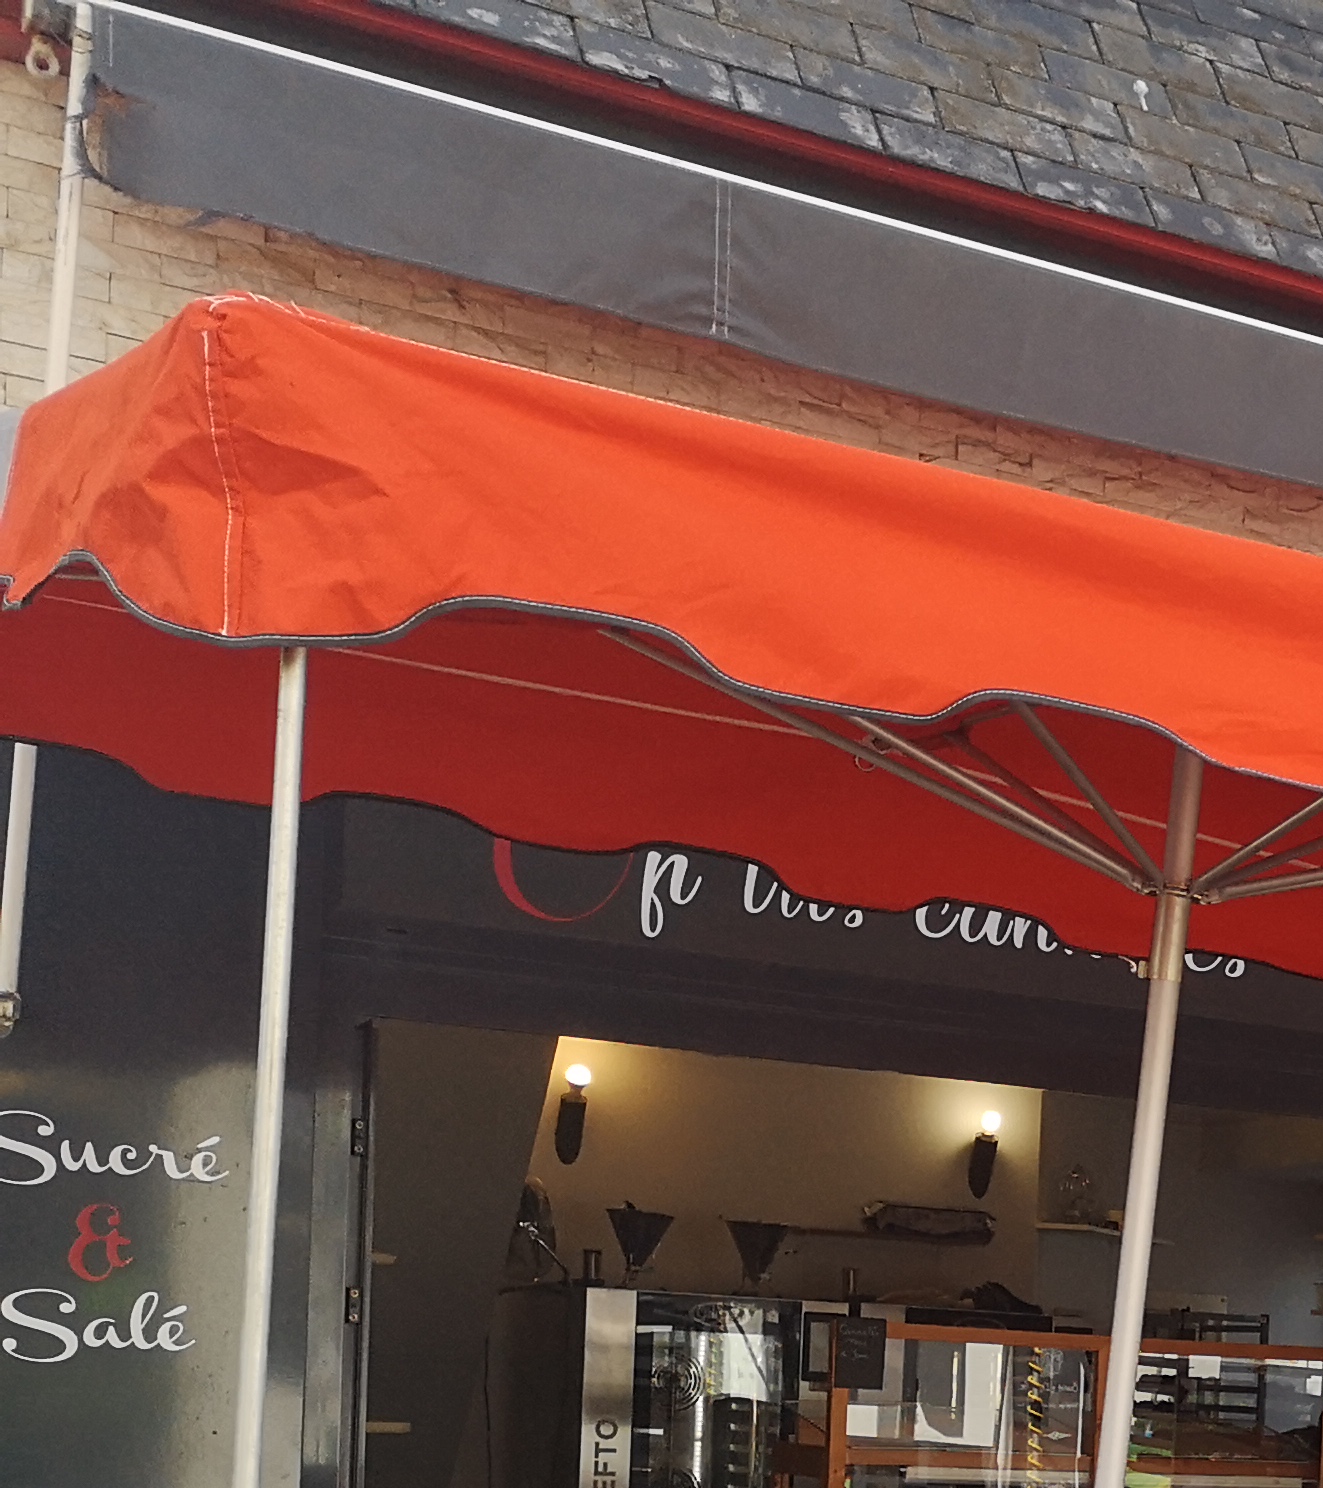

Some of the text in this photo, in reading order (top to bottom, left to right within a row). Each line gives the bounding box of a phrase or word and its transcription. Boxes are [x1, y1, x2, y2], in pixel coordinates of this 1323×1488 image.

[0, 1110, 229, 1185] Sucré
[68, 1204, 133, 1282] &
[1, 1288, 195, 1363] Salé
